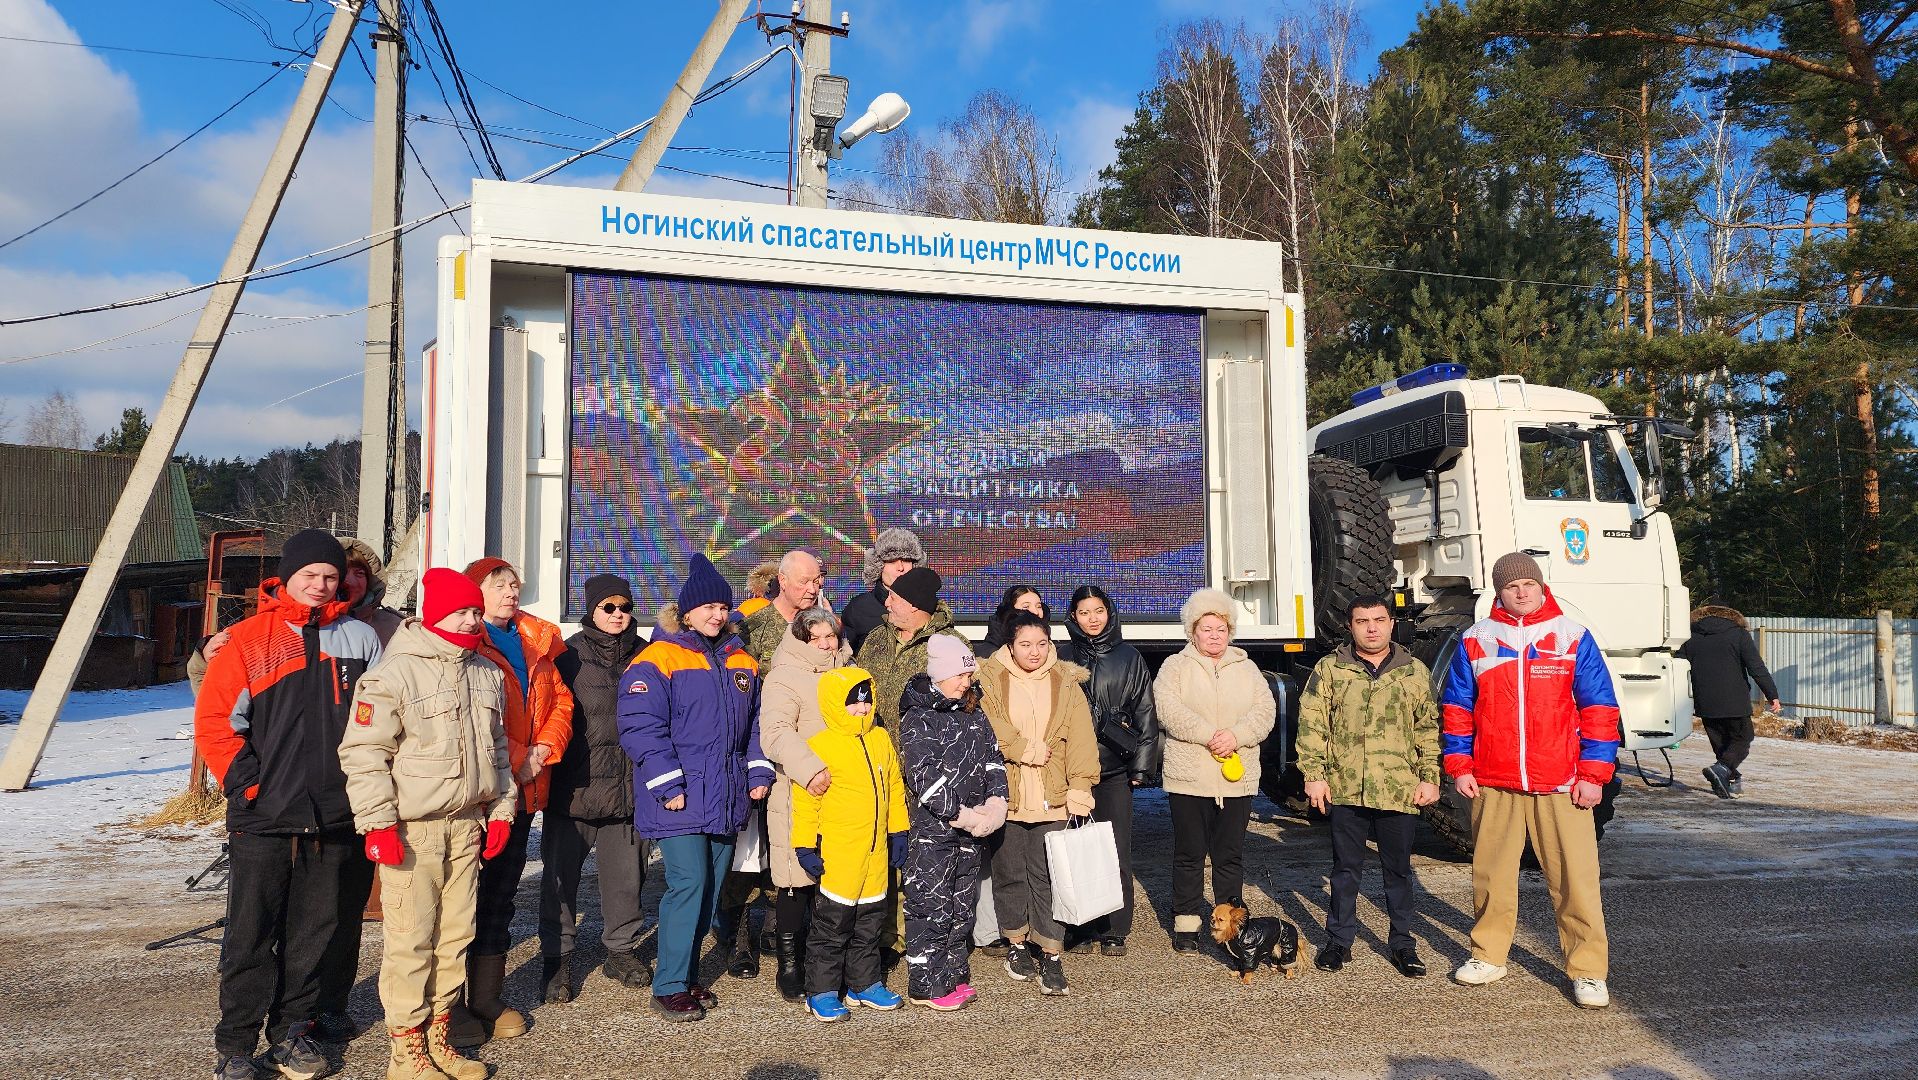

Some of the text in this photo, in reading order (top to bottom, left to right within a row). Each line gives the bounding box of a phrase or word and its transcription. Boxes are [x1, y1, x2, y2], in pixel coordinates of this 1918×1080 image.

[602, 205, 753, 244] Ногинский
[761, 223, 955, 258] спасательный
[1095, 242, 1182, 274] России
[728, 393, 861, 486] 23
[910, 477, 1081, 499] ЗАЩИТНИКА
[911, 508, 1077, 530] ОТЕЧЕСТВА!
